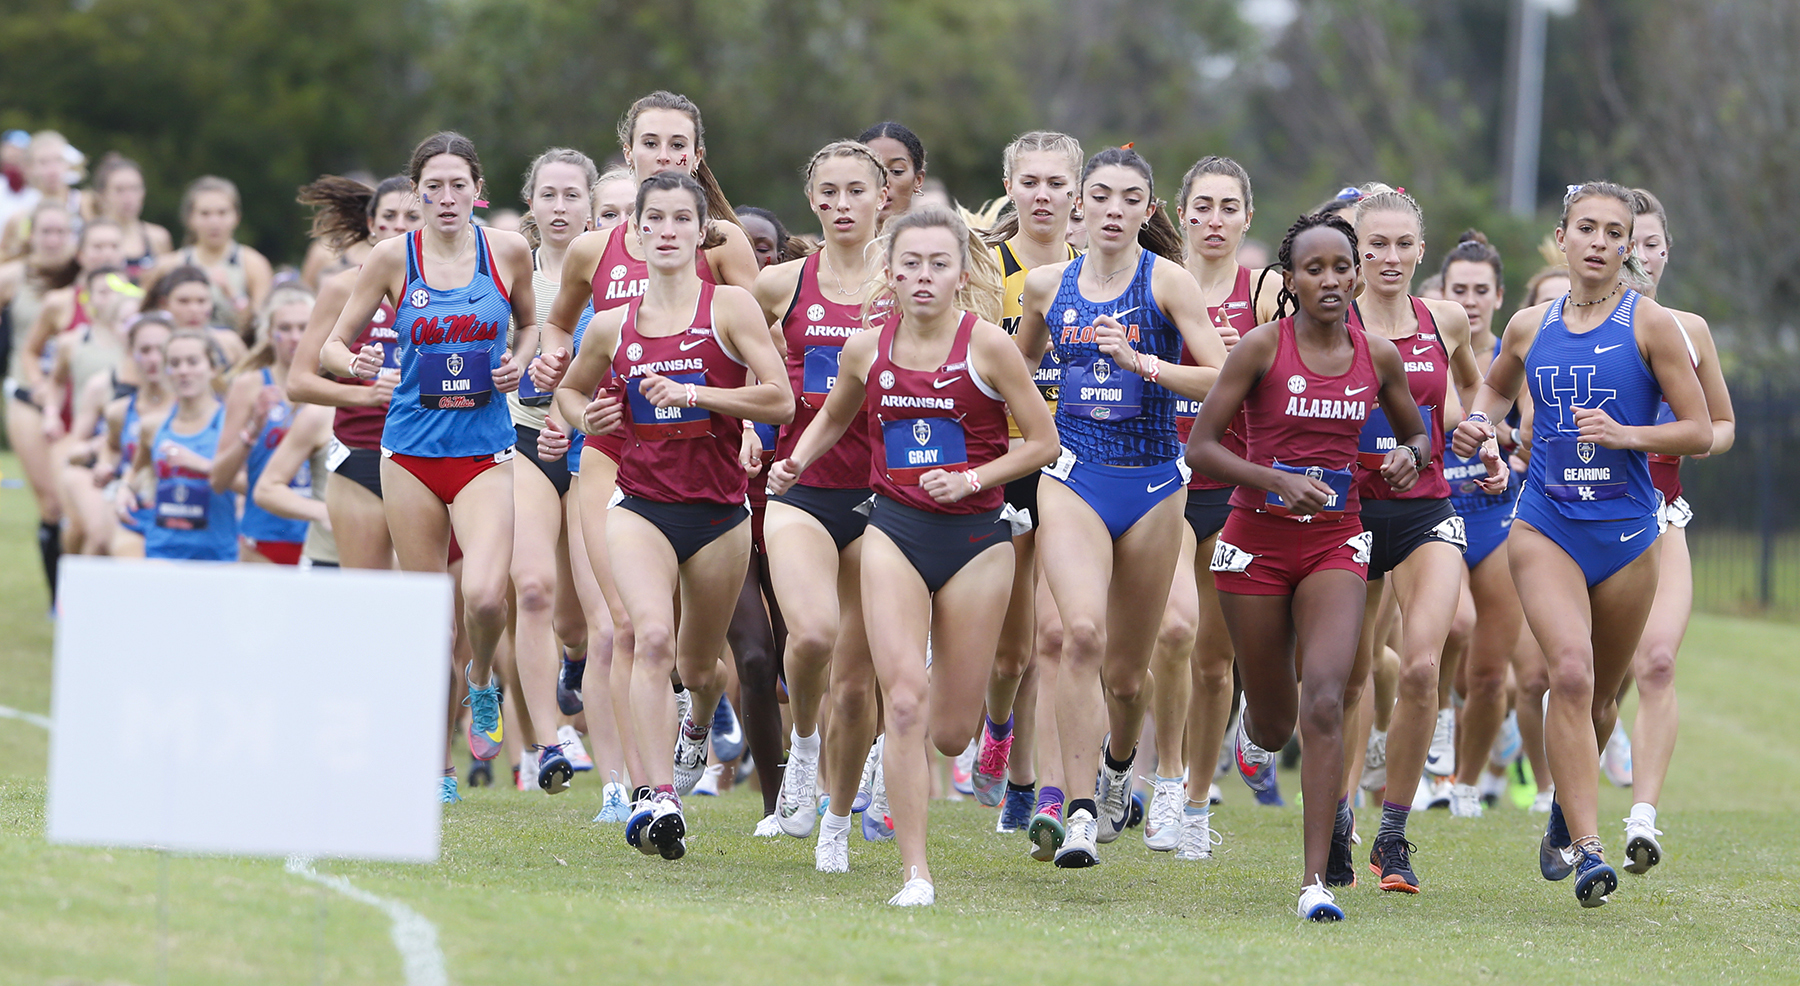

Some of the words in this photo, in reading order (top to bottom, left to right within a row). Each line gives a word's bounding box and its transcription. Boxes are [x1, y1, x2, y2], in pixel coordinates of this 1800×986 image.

[411, 289, 429, 308] SEC
[411, 316, 445, 345] Ole
[443, 313, 498, 344] Miss
[1060, 324, 1140, 344] FLOA
[629, 358, 703, 377] ARKANSAS
[1033, 369, 1061, 381] CHAP
[442, 379, 470, 391] ELKIN
[1288, 375, 1306, 394] SEC
[881, 395, 955, 410] ARKANSAS
[1081, 387, 1122, 401] SPYROU
[1535, 365, 1616, 432] UK
[655, 406, 681, 419] GEAR
[1285, 396, 1366, 420] ALABAMA
[908, 449, 938, 465] GRAY
[1564, 467, 1610, 481] GEARING
